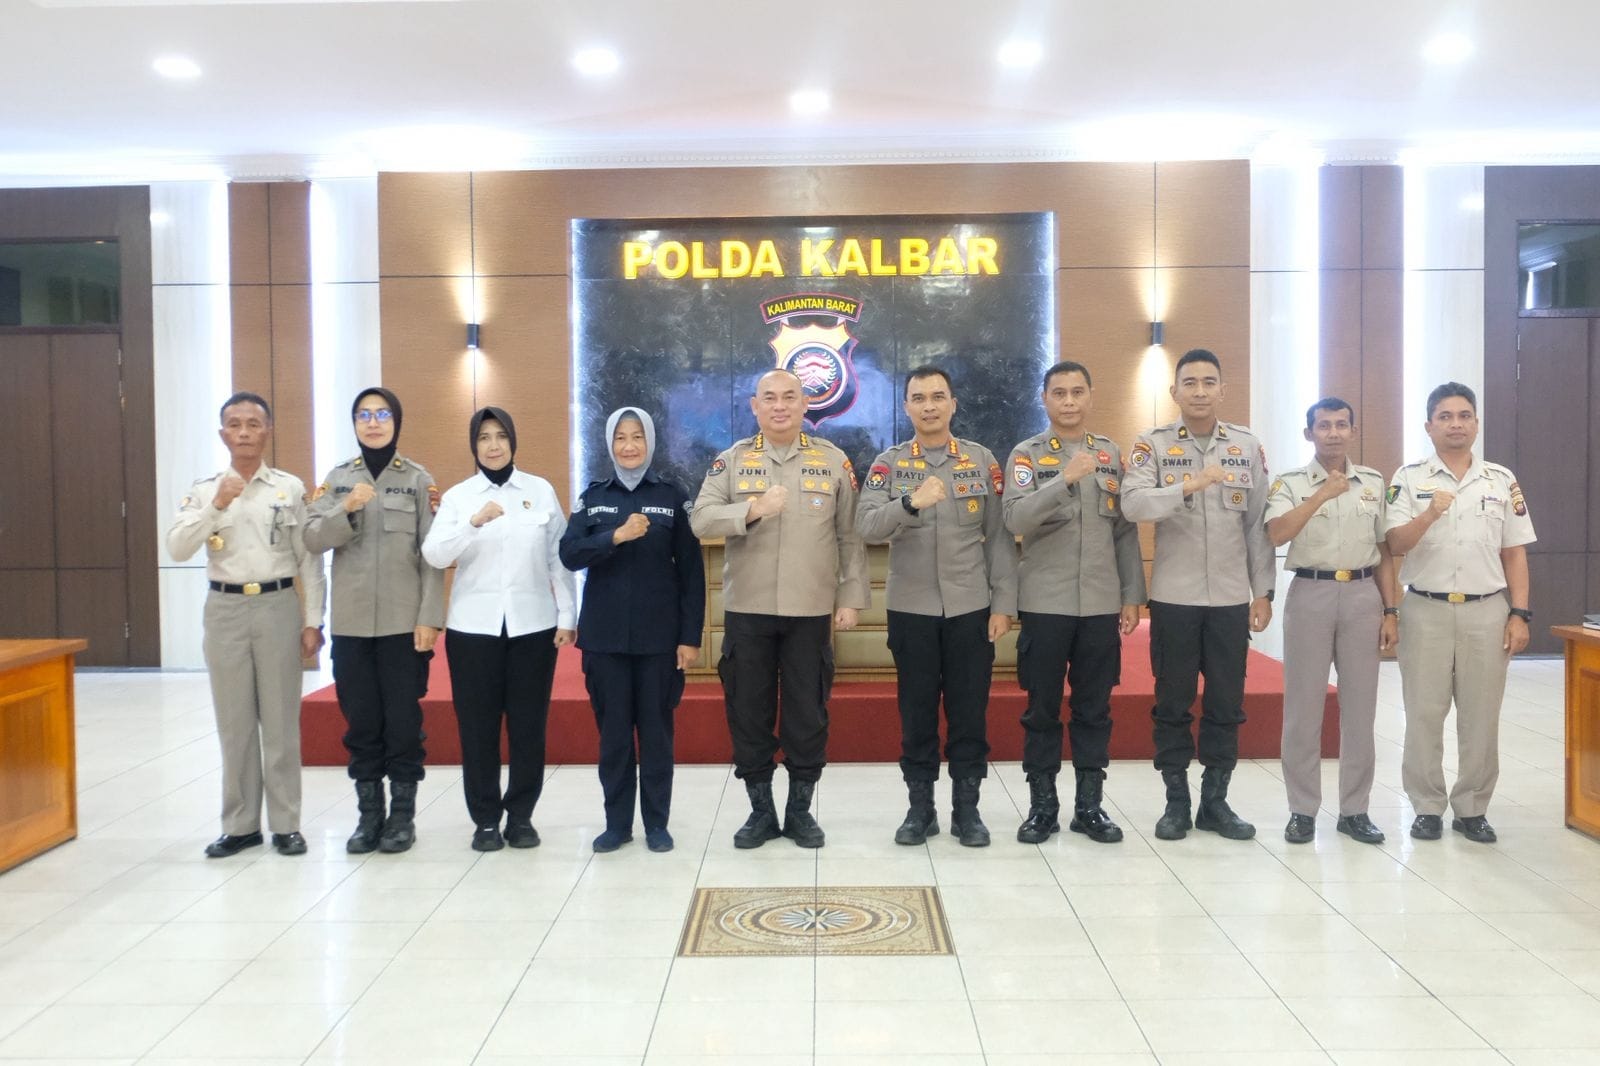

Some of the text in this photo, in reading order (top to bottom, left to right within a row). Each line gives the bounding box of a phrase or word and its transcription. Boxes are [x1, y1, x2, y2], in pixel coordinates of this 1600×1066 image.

[623, 238, 1000, 280] POLDA KALBAR
[767, 298, 857, 316] KALIMANTAN BARAT
[1162, 458, 1250, 467] SWART POLRI
[738, 468, 832, 477] JUNI POLRI
[896, 471, 981, 481] BAYU POLRI
[385, 487, 417, 496] POLRI
